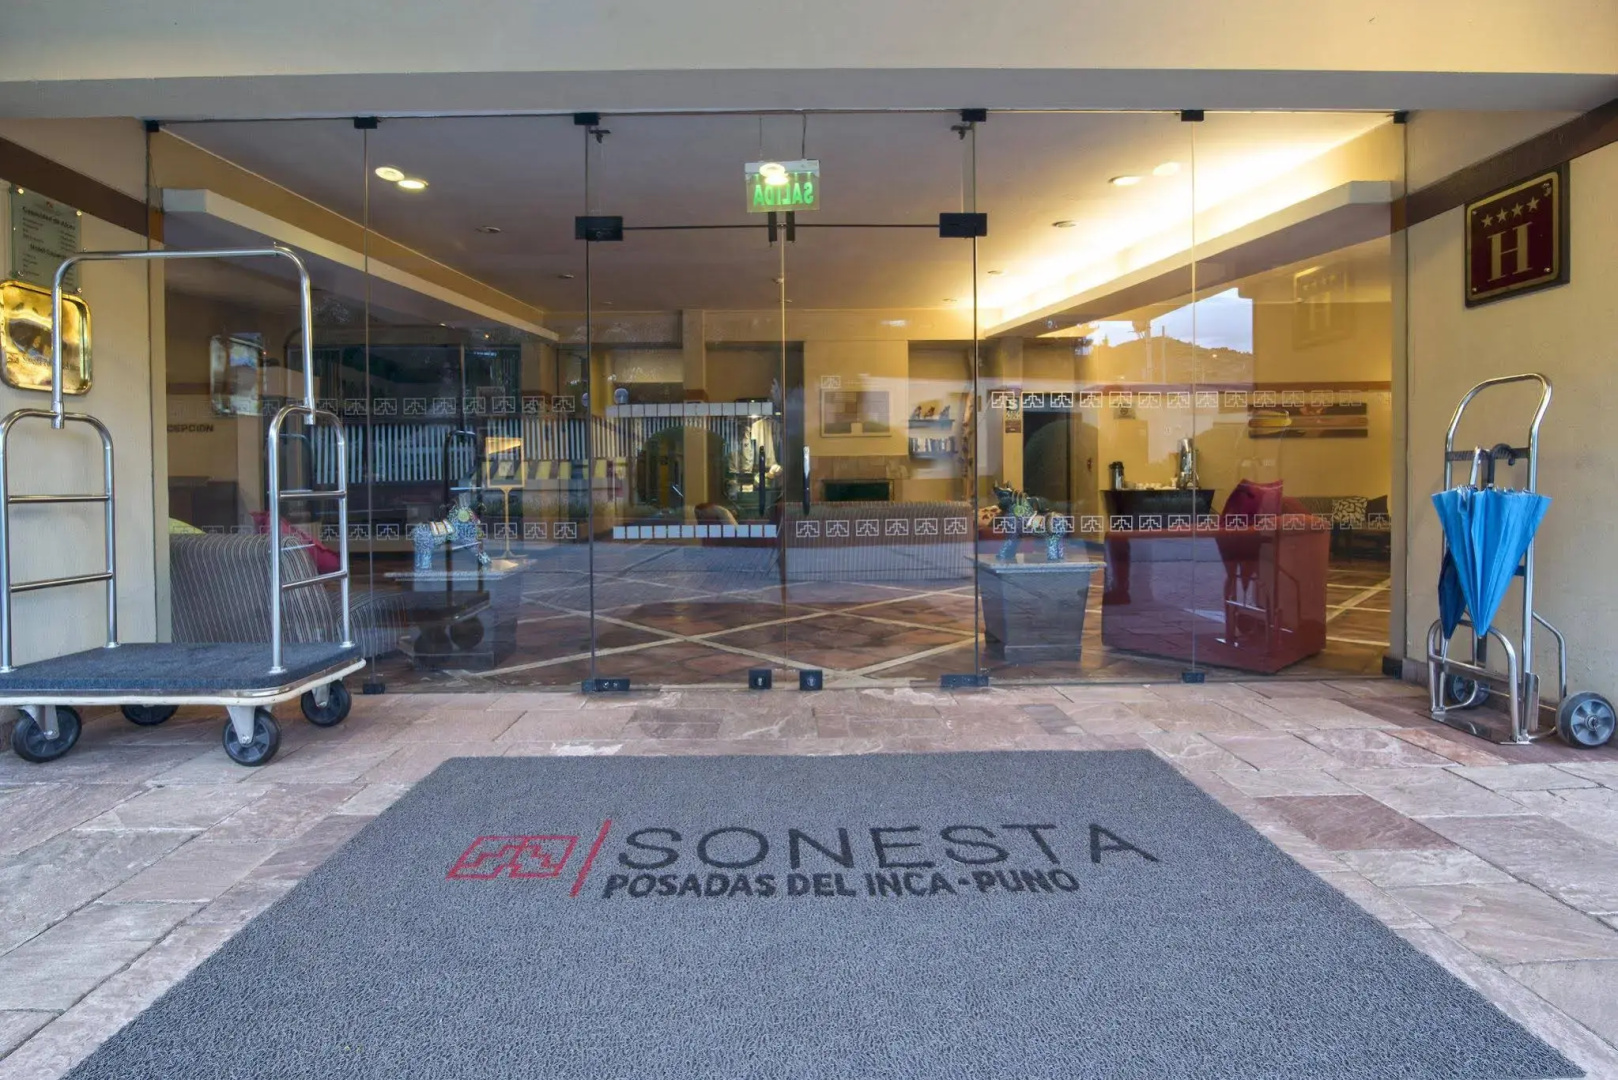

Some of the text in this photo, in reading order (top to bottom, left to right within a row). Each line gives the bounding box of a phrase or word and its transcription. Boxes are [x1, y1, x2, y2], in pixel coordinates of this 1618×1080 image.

[1487, 221, 1533, 282] H
[618, 823, 1161, 870] SONESTA
[603, 873, 777, 898] POSADAS
[787, 872, 856, 897] DEL
